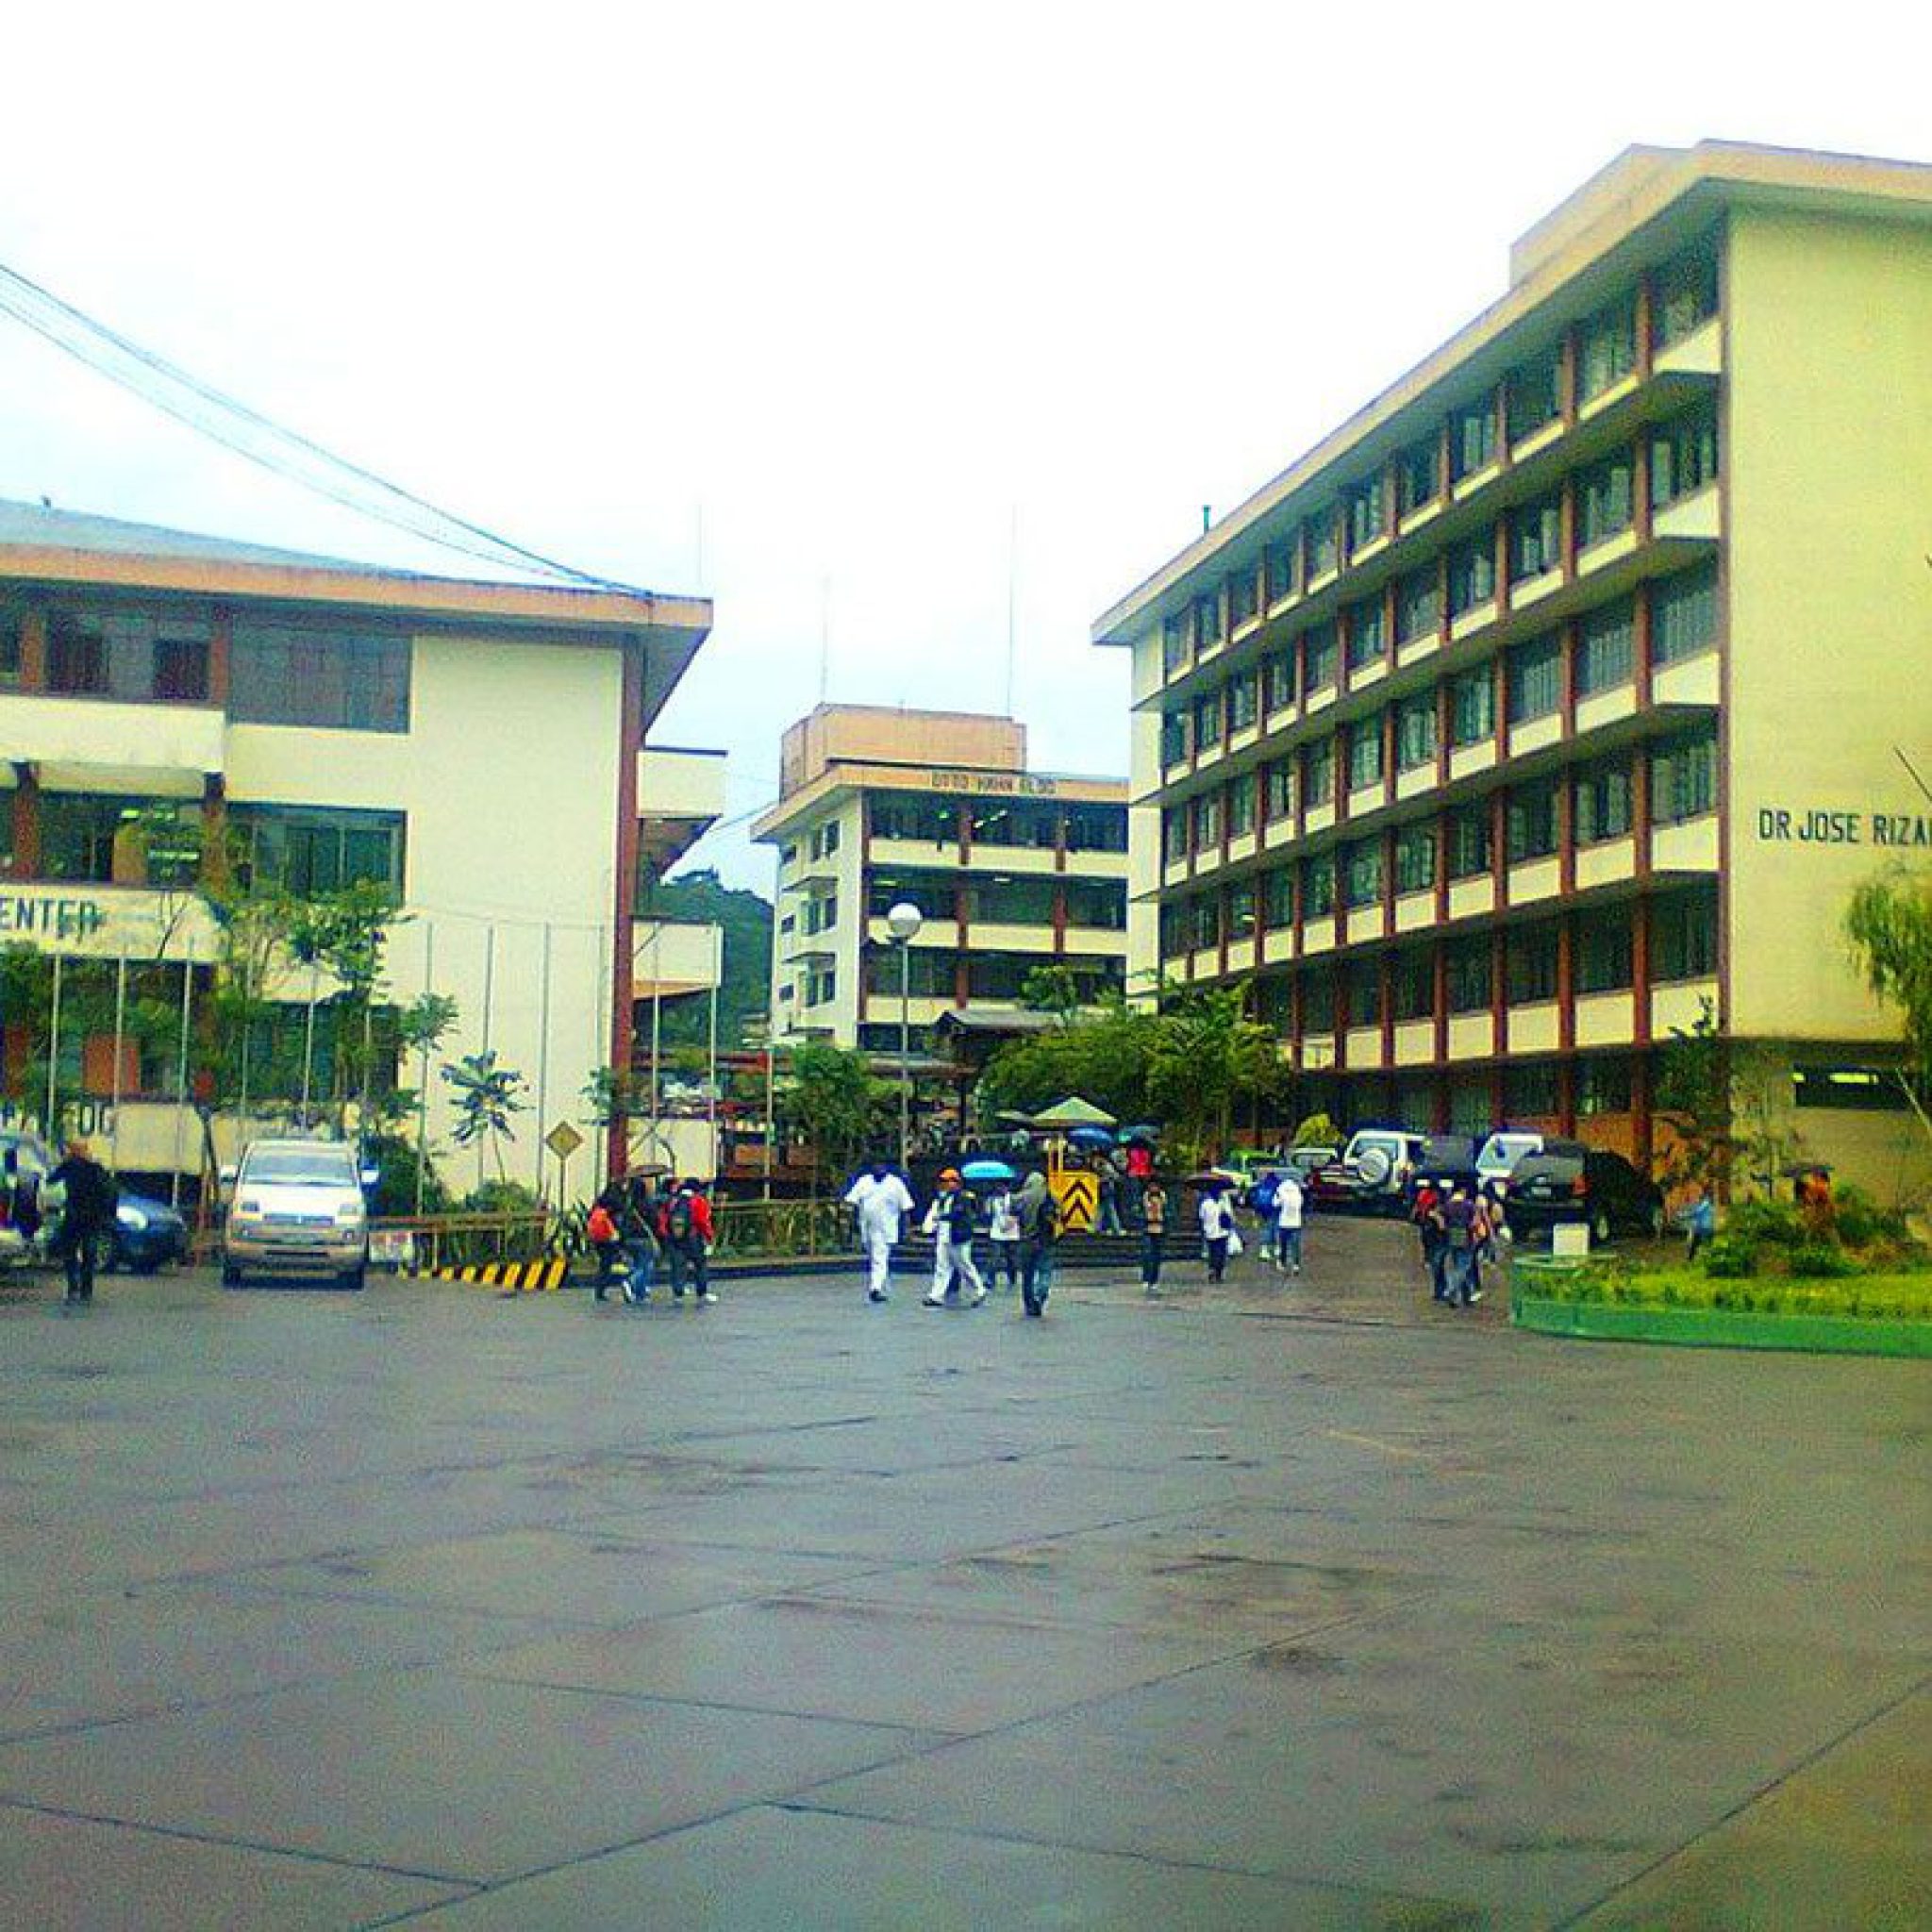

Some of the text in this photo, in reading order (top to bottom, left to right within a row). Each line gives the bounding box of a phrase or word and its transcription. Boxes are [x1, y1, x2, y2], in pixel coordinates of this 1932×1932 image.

[1758, 808, 1932, 846] DR JOSE RIZA
